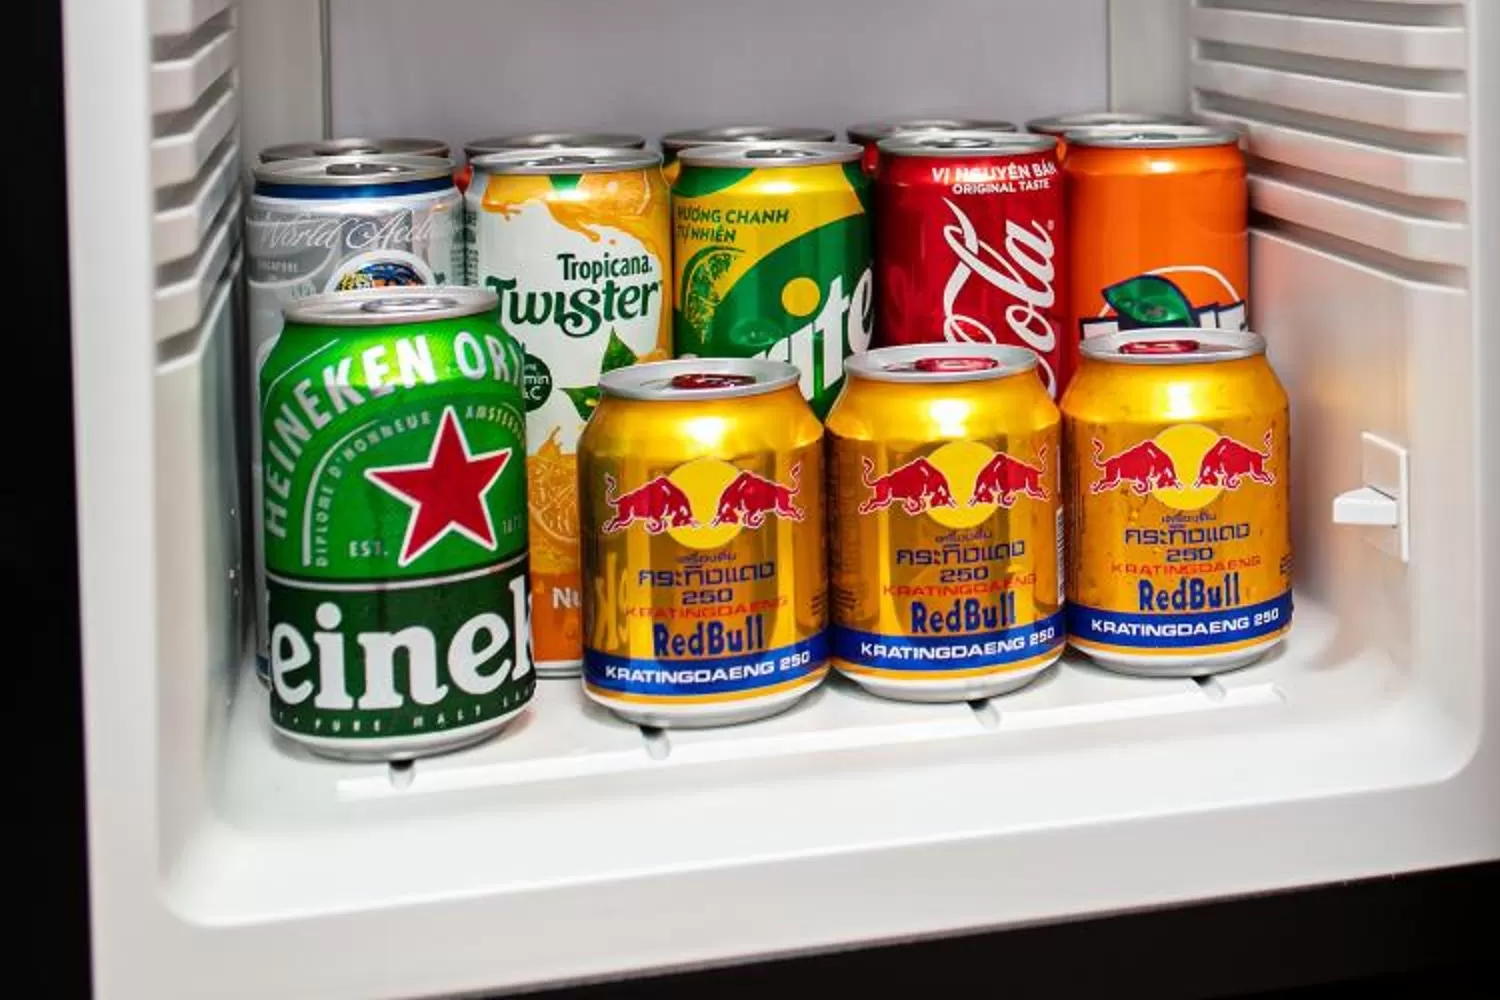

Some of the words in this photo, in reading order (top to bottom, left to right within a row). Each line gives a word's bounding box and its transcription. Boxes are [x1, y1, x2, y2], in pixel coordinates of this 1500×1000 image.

[932, 167, 950, 185] VỊ
[952, 183, 1016, 194] ORIGINAL
[1018, 178, 1050, 191] TASTE
[725, 208, 789, 224] CHANH
[557, 252, 650, 284] Tropicana
[485, 276, 659, 338] Twister
[265, 334, 437, 540] HEINEKEN
[1166, 547, 1213, 562] 250
[940, 566, 988, 583] 250
[682, 588, 733, 605] 250
[1138, 572, 1239, 611] RedBull
[911, 591, 1015, 633] RedBull
[1091, 617, 1249, 638] KRATINGDAENG
[1254, 607, 1279, 626] 250
[653, 614, 763, 657] RedBull
[861, 638, 1025, 660] KRATINGDAENG
[1029, 626, 1055, 645] 250
[605, 661, 775, 684] KRATINGDAENG
[780, 651, 811, 670] 250
